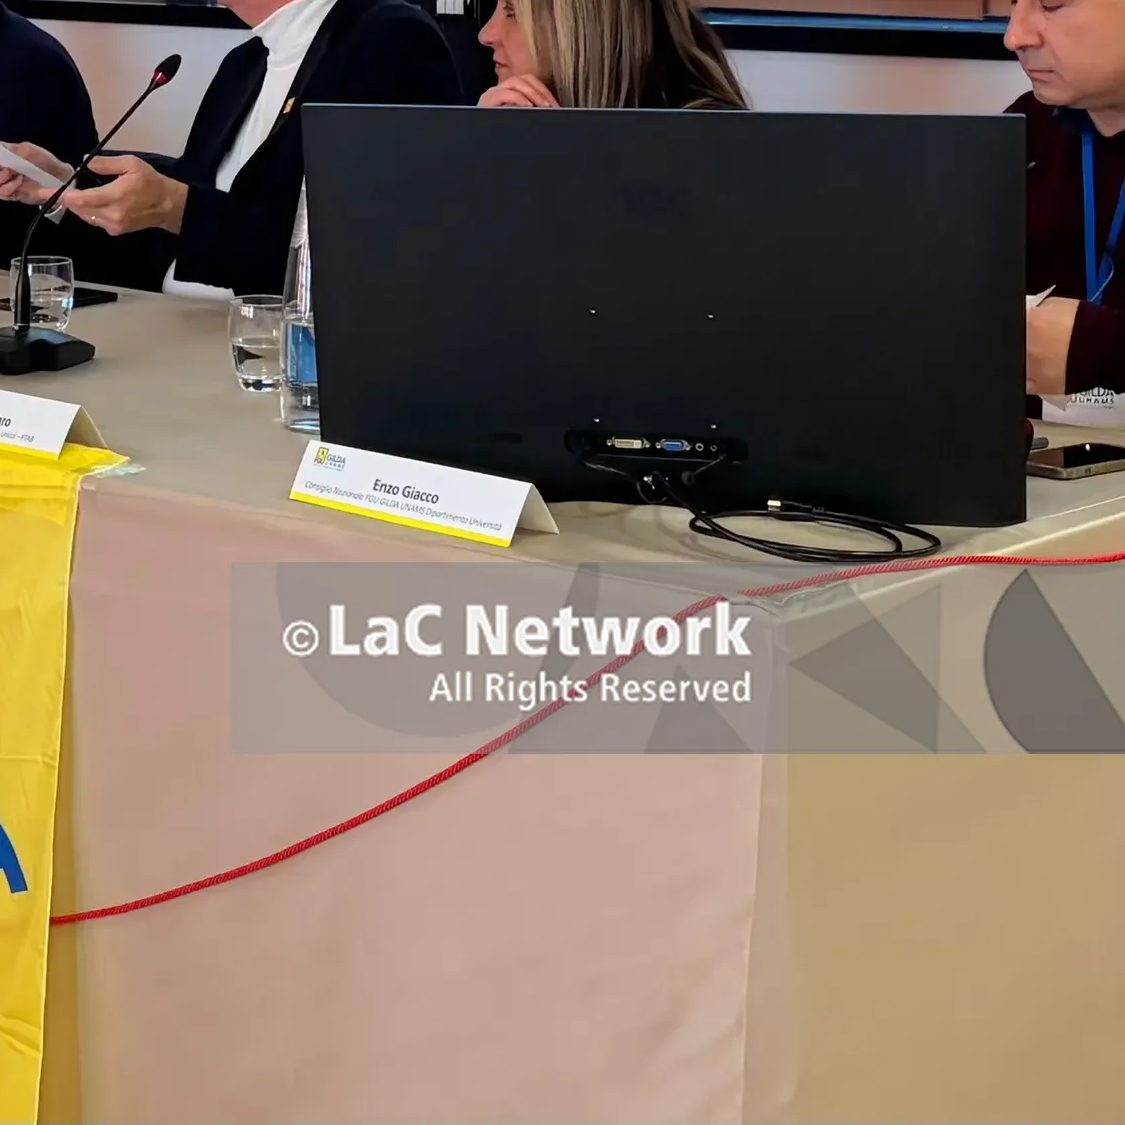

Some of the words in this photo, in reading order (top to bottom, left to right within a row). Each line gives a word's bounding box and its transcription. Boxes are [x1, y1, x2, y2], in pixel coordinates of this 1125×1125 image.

[372, 478, 400, 496] Enzo
[401, 485, 439, 505] Giacco
[379, 497, 400, 511] GILDA
[426, 507, 469, 525] Dipartimento
